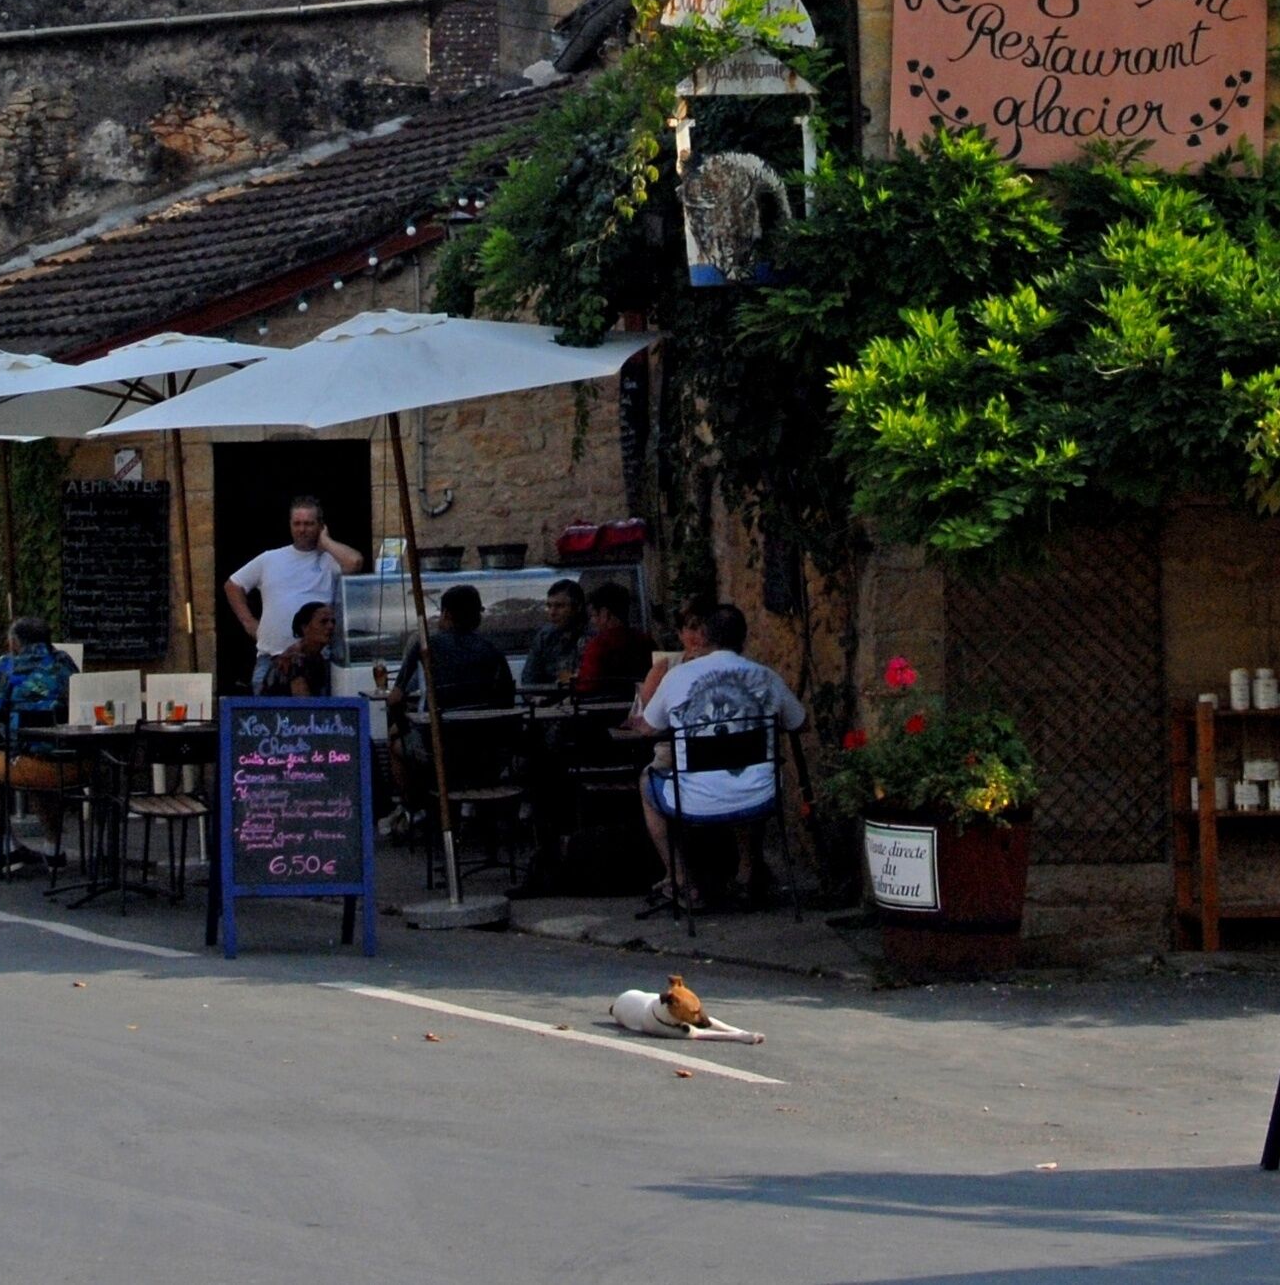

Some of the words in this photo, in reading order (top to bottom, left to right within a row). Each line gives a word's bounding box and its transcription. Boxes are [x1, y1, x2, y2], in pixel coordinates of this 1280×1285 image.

[948, 3, 1214, 76] Restaurant
[992, 75, 1177, 161] glacier
[238, 714, 271, 736] Nos
[311, 750, 325, 763] de
[888, 840, 928, 859] directe
[268, 855, 337, 876] 6,50€
[881, 857, 897, 876] du
